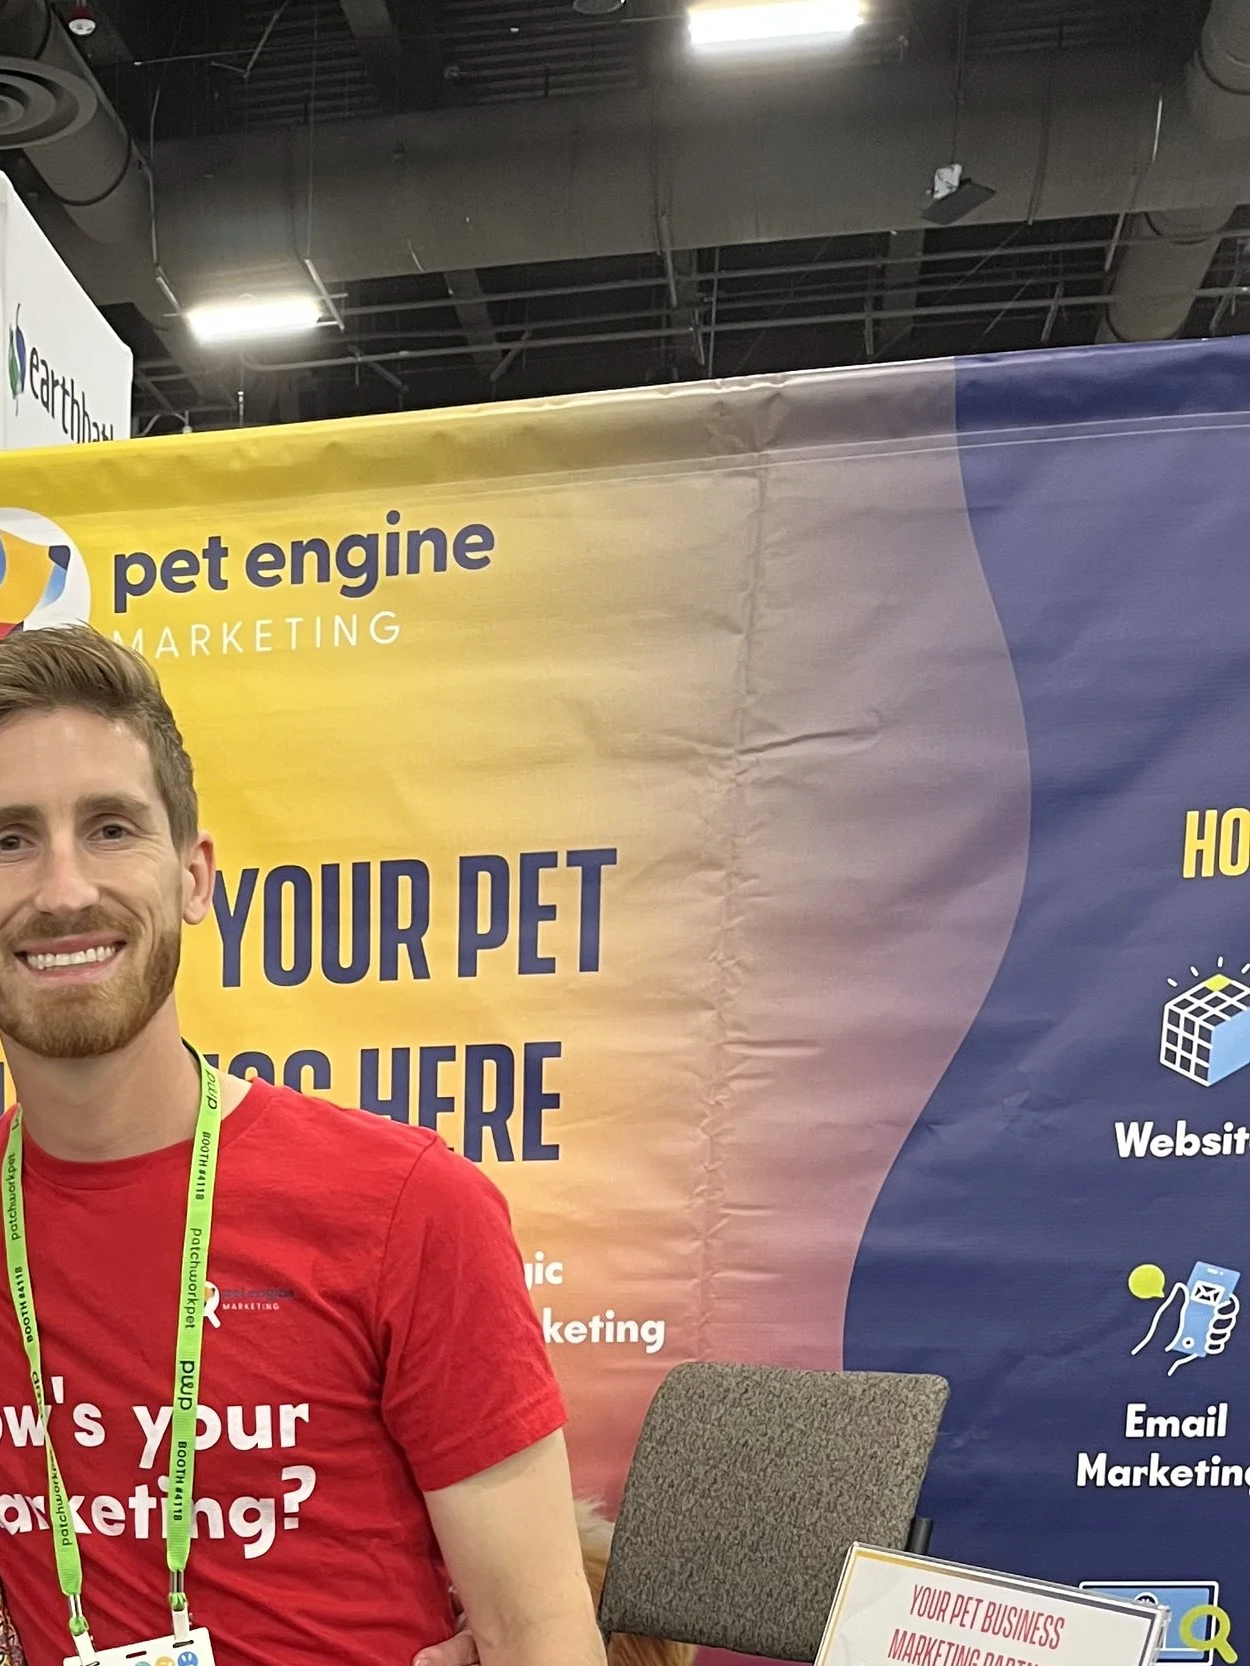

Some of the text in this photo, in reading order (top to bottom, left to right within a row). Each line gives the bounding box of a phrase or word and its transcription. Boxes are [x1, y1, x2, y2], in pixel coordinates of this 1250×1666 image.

[114, 509, 495, 614] pet engine
[111, 611, 401, 660] MARKETING
[214, 848, 618, 988] YOUR PET
[360, 1040, 562, 1163] HERE
[199, 1131, 212, 1167] BOOTH
[1114, 1119, 1250, 1158] Websit
[4, 1152, 21, 1241] patchworkpet
[185, 1228, 202, 1329] patchworkpet
[222, 1303, 280, 1311] MARKETING
[20, 1301, 34, 1344] BOOTH
[542, 1307, 665, 1354] keting
[132, 1402, 310, 1470] your
[1125, 1402, 1229, 1438] Email
[173, 1440, 187, 1521] BOOTH #4118
[910, 1584, 1065, 1650] YOUR PET BUSINESS
